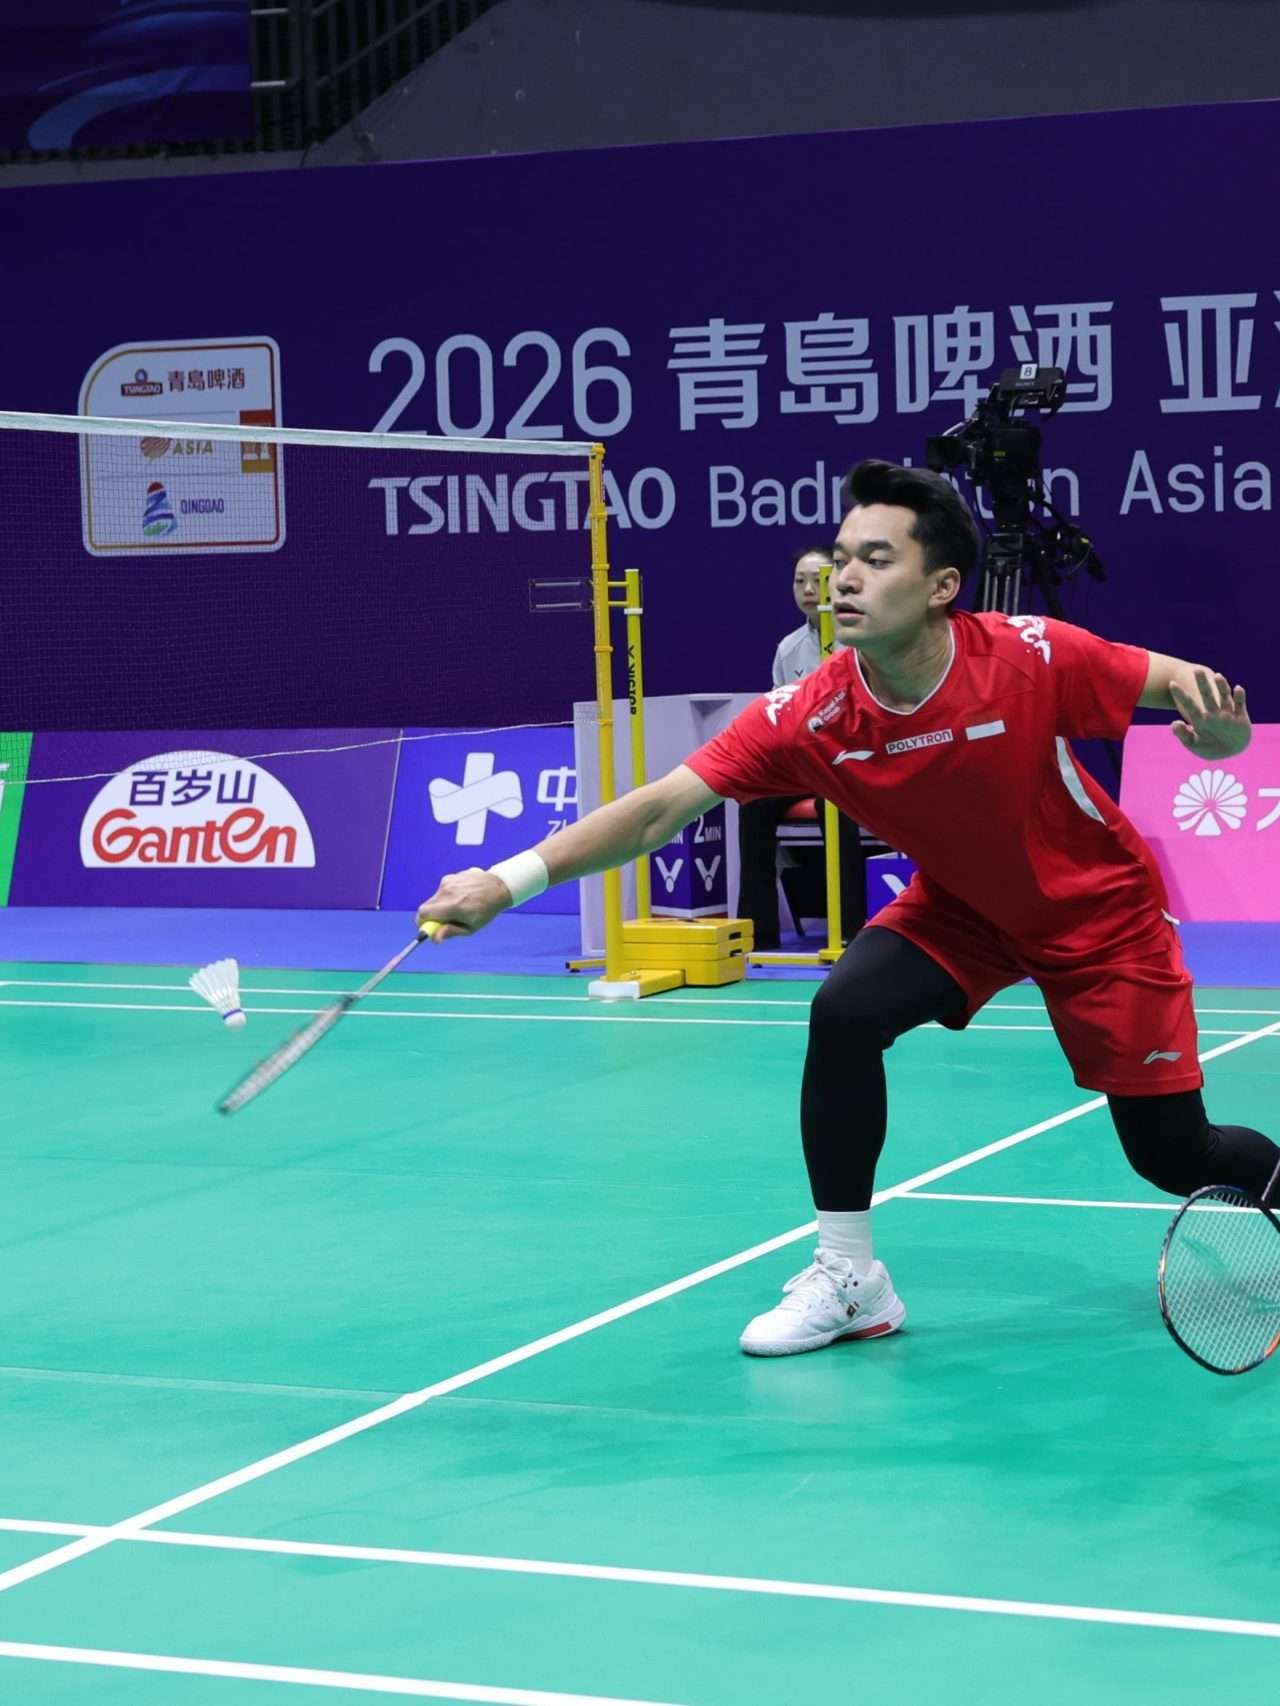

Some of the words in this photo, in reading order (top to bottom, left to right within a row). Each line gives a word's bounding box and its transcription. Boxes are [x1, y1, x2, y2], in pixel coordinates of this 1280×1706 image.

[368, 326, 632, 438] 2026
[1023, 366, 1033, 377] 8
[172, 440, 214, 455] ASIA
[368, 467, 676, 535] TSINGTAO
[1119, 446, 1271, 514] Asia
[888, 731, 952, 754] POLYTRON
[129, 769, 257, 806] 百岁山
